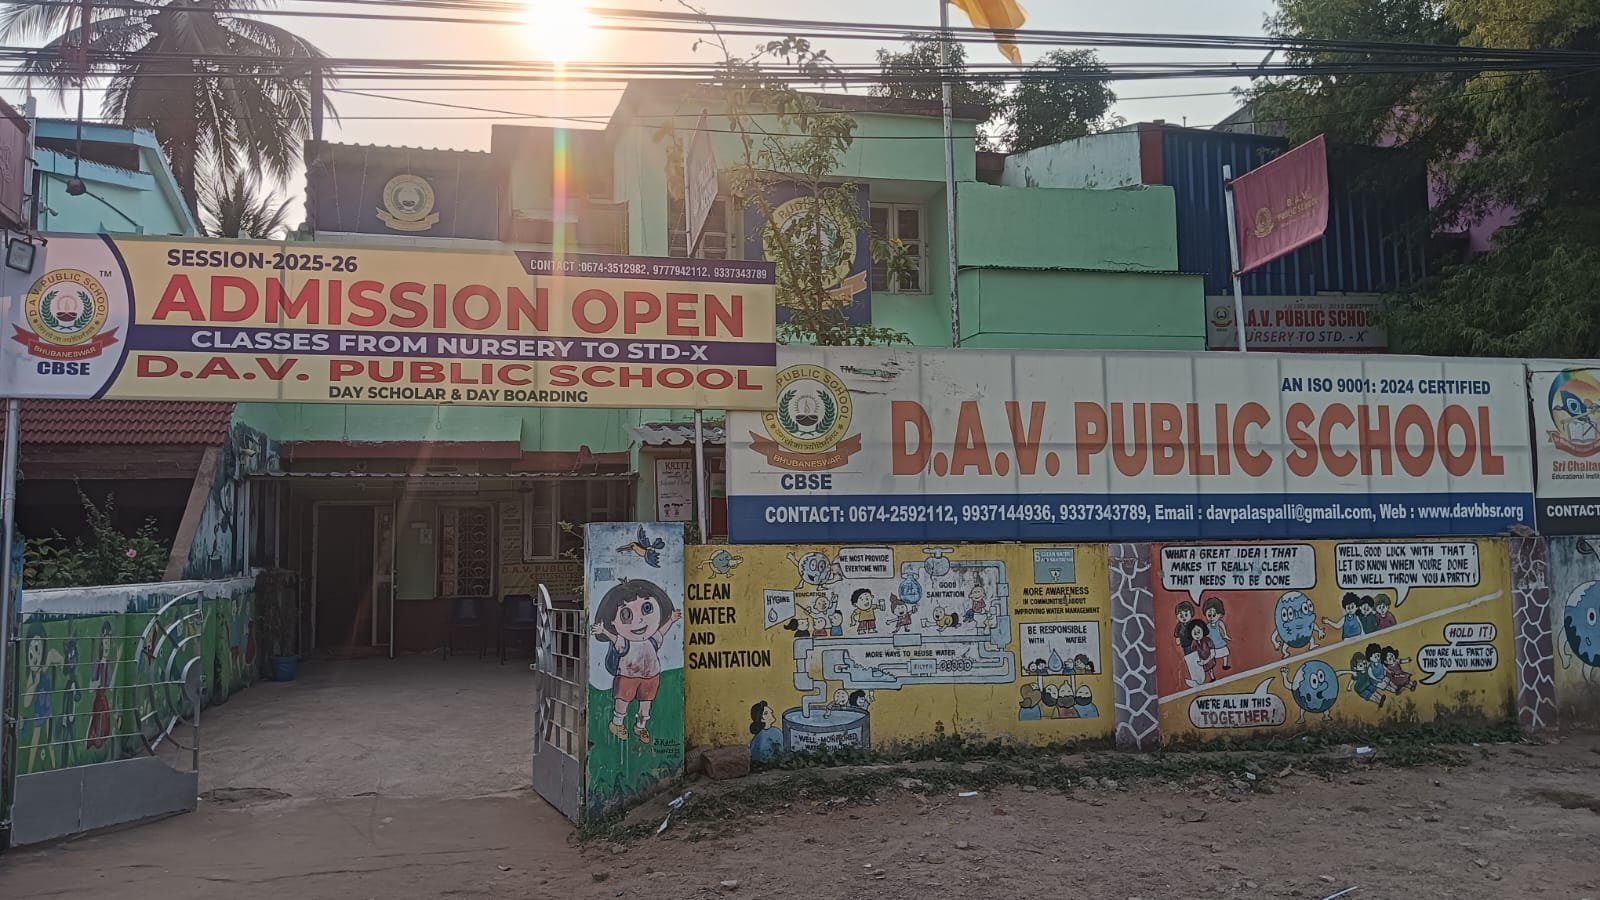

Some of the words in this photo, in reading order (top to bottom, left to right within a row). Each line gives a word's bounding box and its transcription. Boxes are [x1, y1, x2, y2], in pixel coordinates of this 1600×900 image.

[167, 249, 358, 273] SESSION-2025-26
[530, 259, 576, 272] CONTACT
[713, 267, 767, 280] 9337343789
[40, 272, 81, 288] PUBLIC
[83, 277, 106, 318] SCHOOL
[151, 273, 549, 332] ADMISSION
[571, 288, 744, 338] OPEN
[1234, 309, 1273, 328] .A.V.
[1275, 310, 1326, 327] PUBLIC
[1298, 331, 1316, 342] TO
[1319, 331, 1346, 343] STD.
[1356, 331, 1367, 342] X
[33, 345, 97, 358] BHUBANESWAR
[191, 330, 329, 351] CLASSES
[339, 333, 427, 354] FROM
[438, 337, 574, 358] NURSERY
[581, 340, 620, 359] TO
[627, 342, 709, 361] STD-X
[37, 361, 91, 375] CBSE
[136, 355, 310, 382] D.A.V.
[328, 359, 533, 386] PUBLIC
[549, 364, 764, 391] SCHOOL
[1281, 377, 1303, 392] AN
[1307, 378, 1333, 393] ISO
[1337, 378, 1376, 394] 9001:
[1380, 379, 1415, 394] 2024
[1418, 380, 1491, 395] CERTIFIED
[329, 386, 363, 399] DAY
[367, 387, 446, 401] SCHOLAR
[450, 388, 461, 401] &
[466, 389, 499, 402] DAY
[503, 389, 588, 403] BOARDING
[776, 368, 821, 388] PUBLIC
[823, 374, 850, 421] SCHOOL
[890, 400, 1061, 477] D.A.V.
[1074, 401, 1274, 477] PUBLIC
[1285, 403, 1505, 478] SCHOOL
[773, 454, 841, 468] BHUBANESWAR
[1552, 460, 1566, 472] Sri
[780, 473, 833, 490] CBSE
[765, 506, 845, 523] CONTACT:
[848, 505, 958, 526] 0674-2592112,
[962, 505, 1055, 525] 9937144936,
[1059, 504, 1152, 524] 9337343789,
[1155, 503, 1194, 521] Email
[1206, 504, 1377, 525] davpalaspalli@gmail.com,
[1379, 503, 1407, 519] Web
[1418, 503, 1524, 521] www.davbbsr.org
[1034, 551, 1041, 562] 6
[1165, 549, 1188, 559] WHAT
[1190, 549, 1196, 559] A
[1199, 548, 1231, 559] GREAT
[1236, 548, 1261, 558] IDEA
[1271, 547, 1299, 558] THAT
[1363, 546, 1382, 557] GOOD
[1386, 545, 1406, 557] LUCK
[1410, 546, 1434, 556] WITH
[1440, 545, 1467, 557] THAT
[839, 555, 849, 563] WE
[864, 554, 889, 562] PROVIDE
[1338, 559, 1353, 572] LET
[1355, 559, 1365, 571] US
[1366, 559, 1387, 571] KNOW
[1390, 559, 1415, 571] WHEN
[1447, 558, 1469, 570] DONE
[873, 564, 887, 572] WITH
[1170, 561, 1202, 572] MAKES
[1206, 561, 1217, 572] IT
[1222, 562, 1255, 572] REALLY
[1261, 561, 1290, 572] CLEAR
[938, 581, 957, 589] GOOD
[1169, 574, 1195, 586] THAT
[1199, 575, 1226, 586] NEEDS
[1232, 575, 1243, 585] TO
[1249, 575, 1260, 585] BE
[1265, 575, 1291, 586] DONE
[1341, 574, 1358, 585] AND
[1388, 572, 1418, 584] THROW
[1421, 573, 1438, 584] YOU
[1440, 574, 1446, 584] A
[1447, 572, 1471, 584] PARTY
[687, 583, 731, 601] CLEAN
[926, 590, 965, 599] SANITATION
[1023, 587, 1043, 596] MORE
[1045, 586, 1089, 596] AWARENESS
[688, 606, 737, 625] WATER
[1028, 626, 1037, 634] BE
[1040, 625, 1088, 634] RESPONSIBLE
[1448, 626, 1474, 638] HOLD
[688, 632, 716, 646] AND
[1065, 636, 1087, 644] WATER
[885, 650, 901, 658] WAYS
[914, 649, 933, 657] REUSE
[936, 648, 956, 657] WATER
[1424, 648, 1436, 658] YOU
[1437, 648, 1449, 657] ARE
[1451, 648, 1464, 657] ALL
[1466, 647, 1484, 657] PART
[1485, 647, 1494, 657] OF
[688, 649, 771, 670] SANITATION
[1422, 658, 1438, 669] THIS
[1439, 658, 1452, 668] TOO
[1454, 658, 1468, 667] YOU
[1470, 657, 1493, 668] KNOW
[1196, 698, 1221, 710] WE'RE
[1222, 698, 1237, 709] ALL
[1240, 698, 1249, 708] IN
[1251, 697, 1272, 708] THIS
[1200, 708, 1270, 726] TOGETHER
